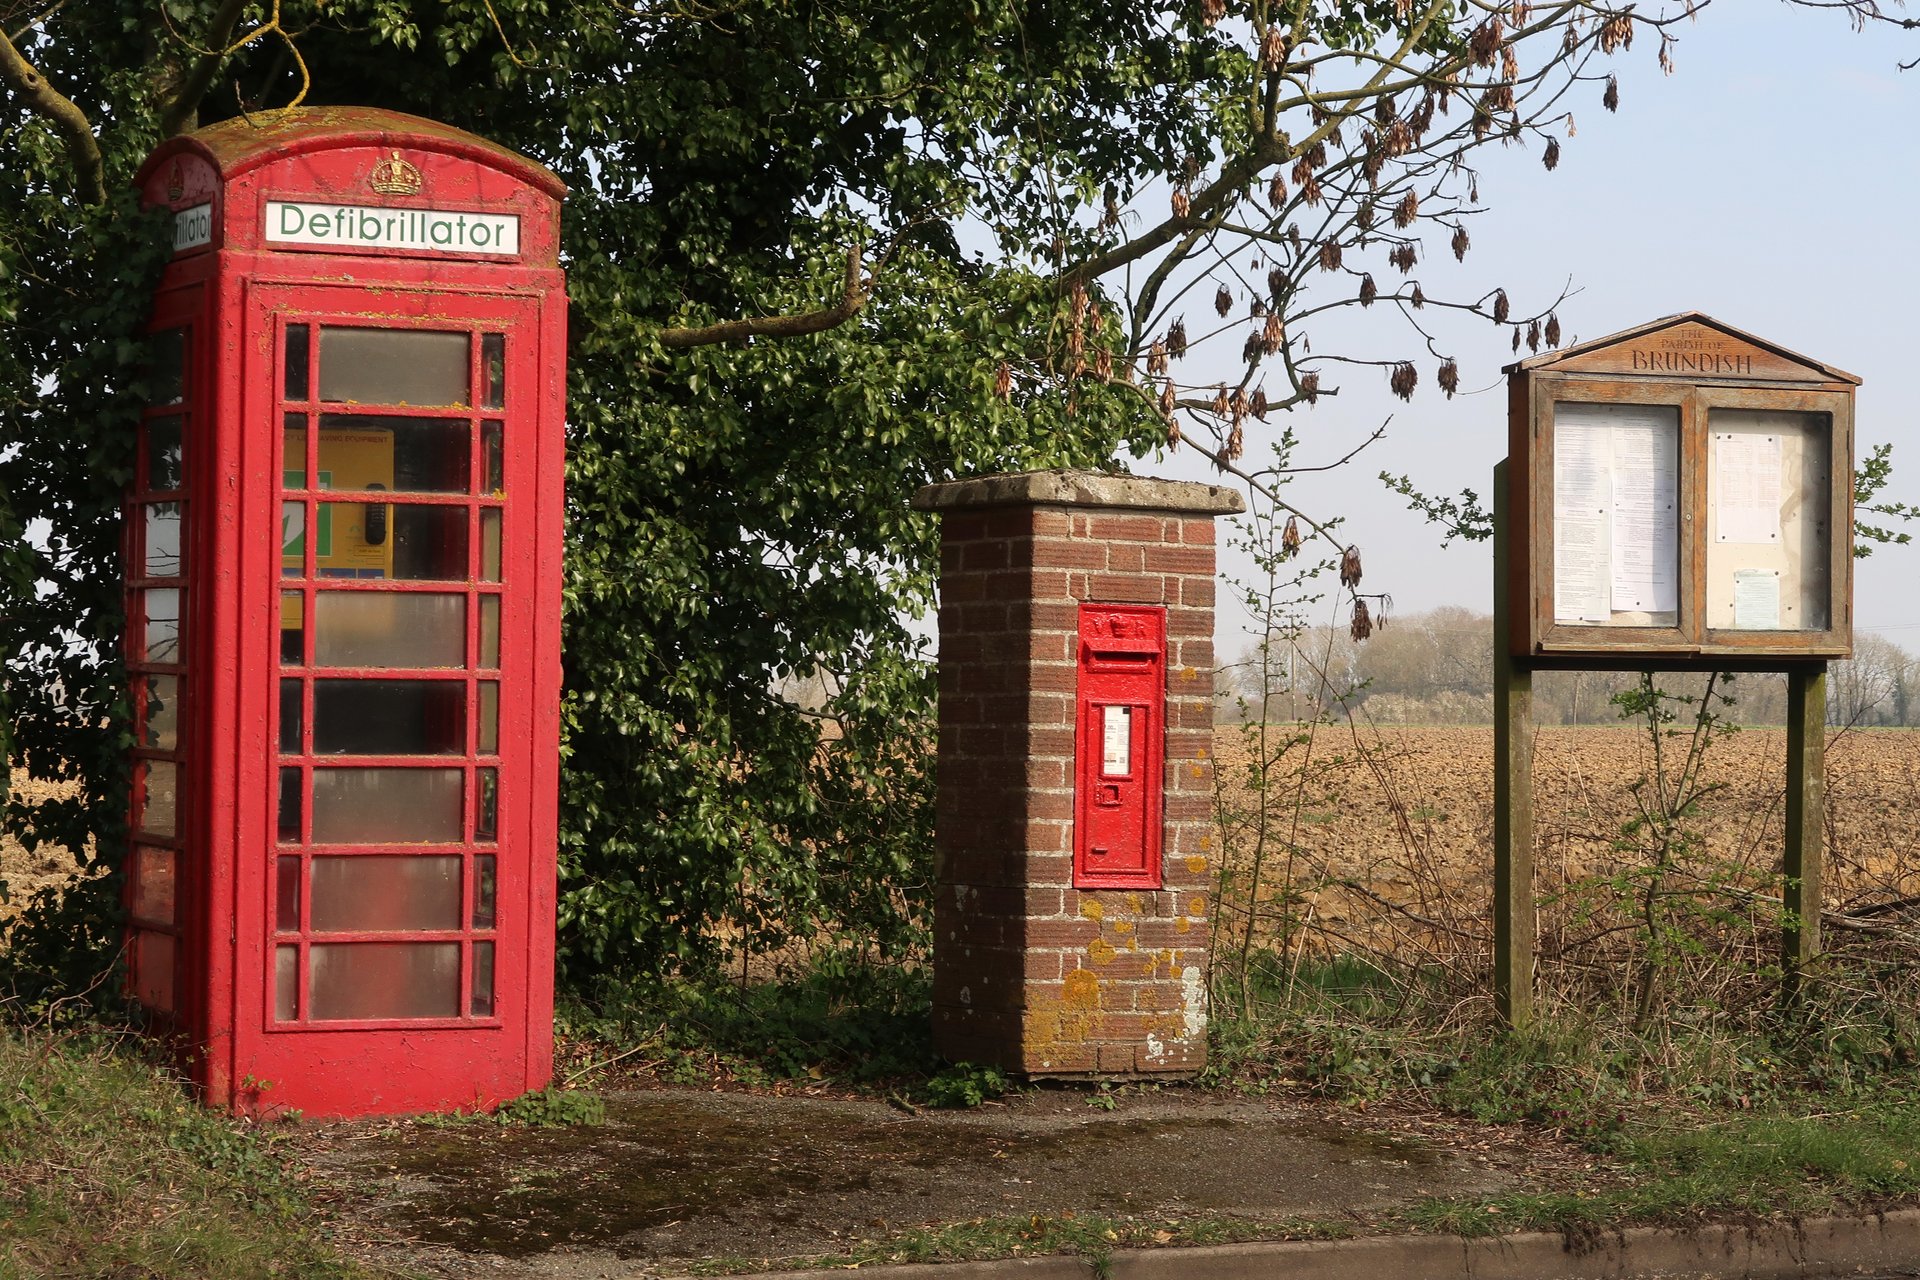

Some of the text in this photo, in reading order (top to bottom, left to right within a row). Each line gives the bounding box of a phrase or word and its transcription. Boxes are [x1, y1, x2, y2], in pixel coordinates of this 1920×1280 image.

[175, 211, 210, 245] rillator
[280, 204, 505, 247] Defibrillator
[1661, 339, 1724, 350] PARISH OF
[1681, 329, 1704, 338] THE
[1632, 350, 1752, 374] BRUNDISH
